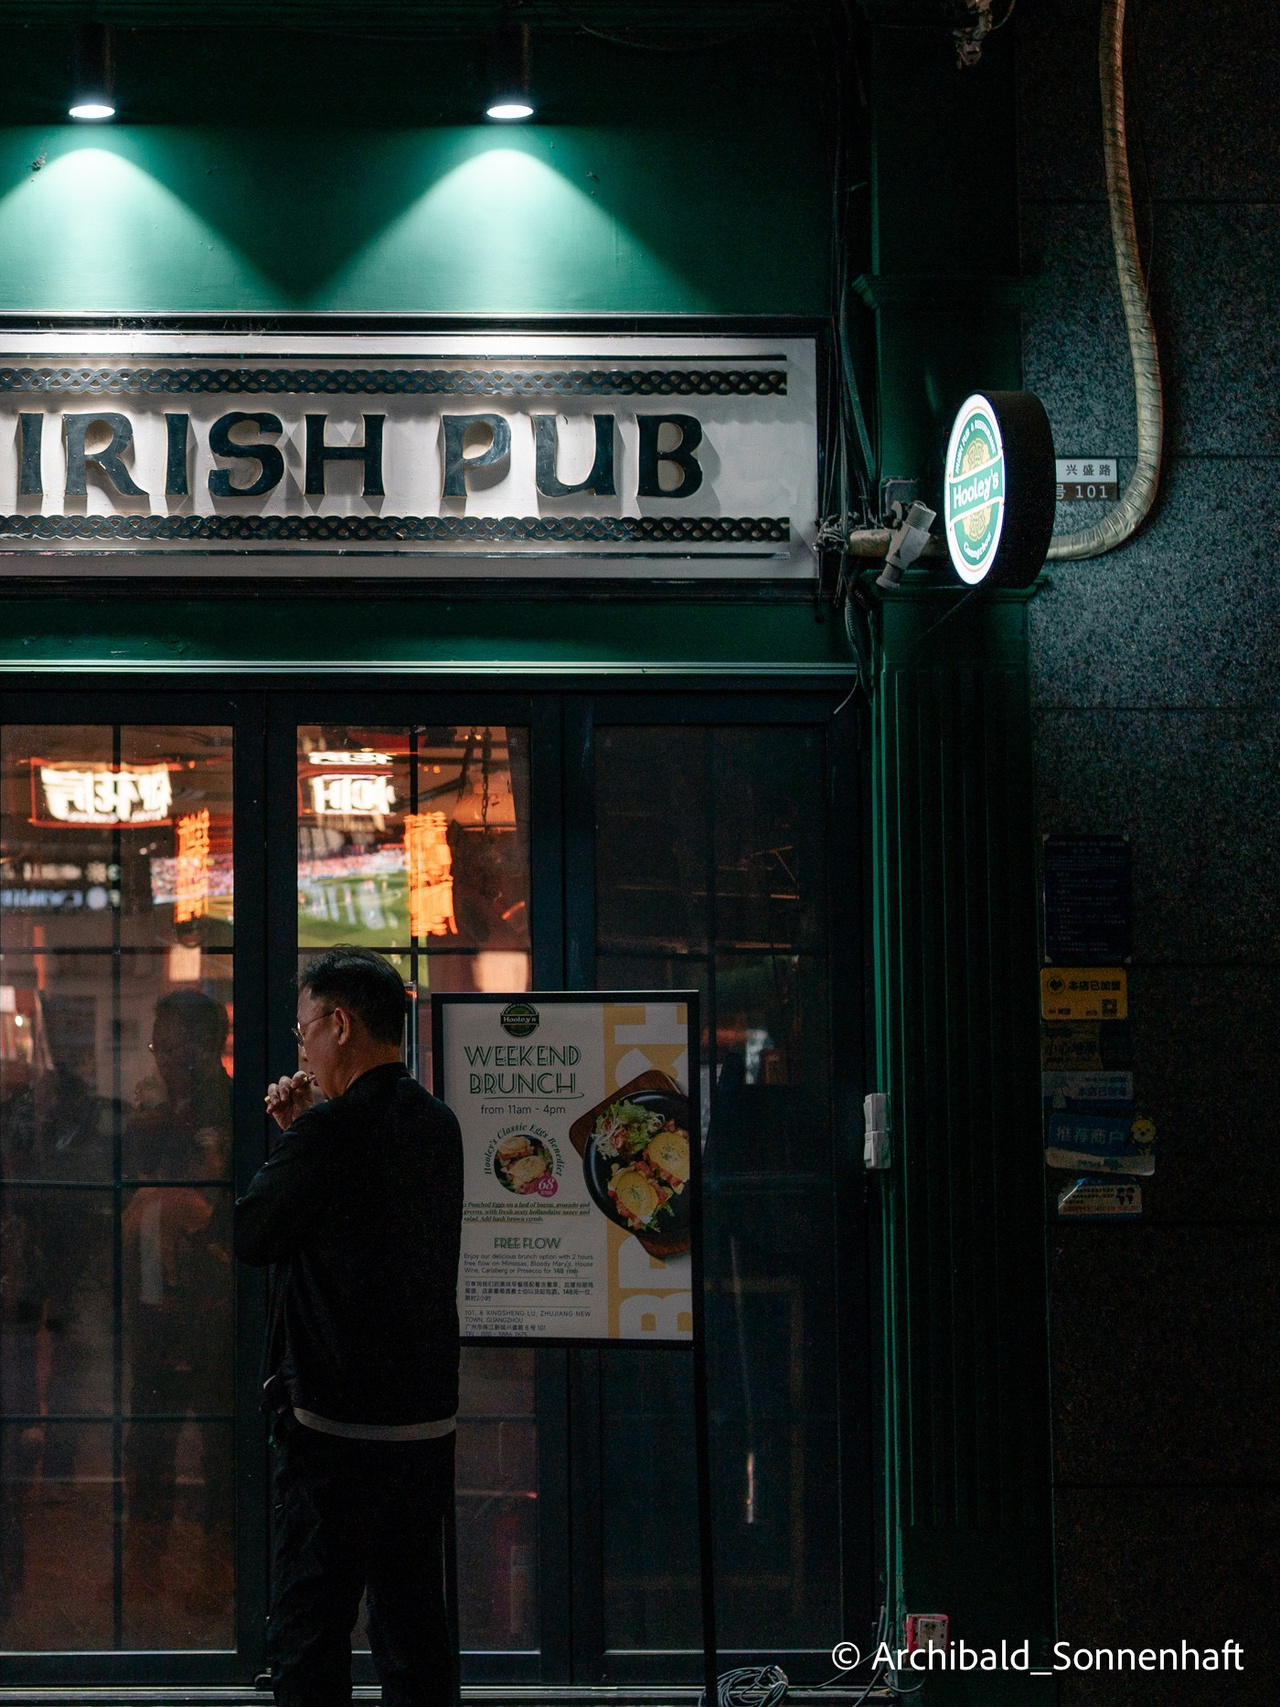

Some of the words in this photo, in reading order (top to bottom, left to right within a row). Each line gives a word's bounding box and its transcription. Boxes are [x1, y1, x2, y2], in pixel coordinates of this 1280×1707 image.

[16, 410, 386, 498] IRISH
[438, 411, 704, 499] PUB
[1066, 464, 1111, 476] 兴盛路
[953, 469, 999, 509] Hooley's
[1076, 485, 1108, 498] 101
[464, 1045, 582, 1067] WEEKEND
[470, 1072, 576, 1094] BRUNCH
[481, 1105, 504, 1114] from
[508, 1105, 532, 1114] 11am
[543, 1105, 566, 1117] 4pm
[484, 1140, 498, 1175] Hooley's
[498, 1124, 528, 1140] Classic
[529, 1124, 548, 1139] Eggs
[548, 1137, 565, 1177] Benedict
[538, 1179, 554, 1190] 68
[494, 1238, 520, 1248] FREE
[522, 1238, 562, 1248] FLOW
